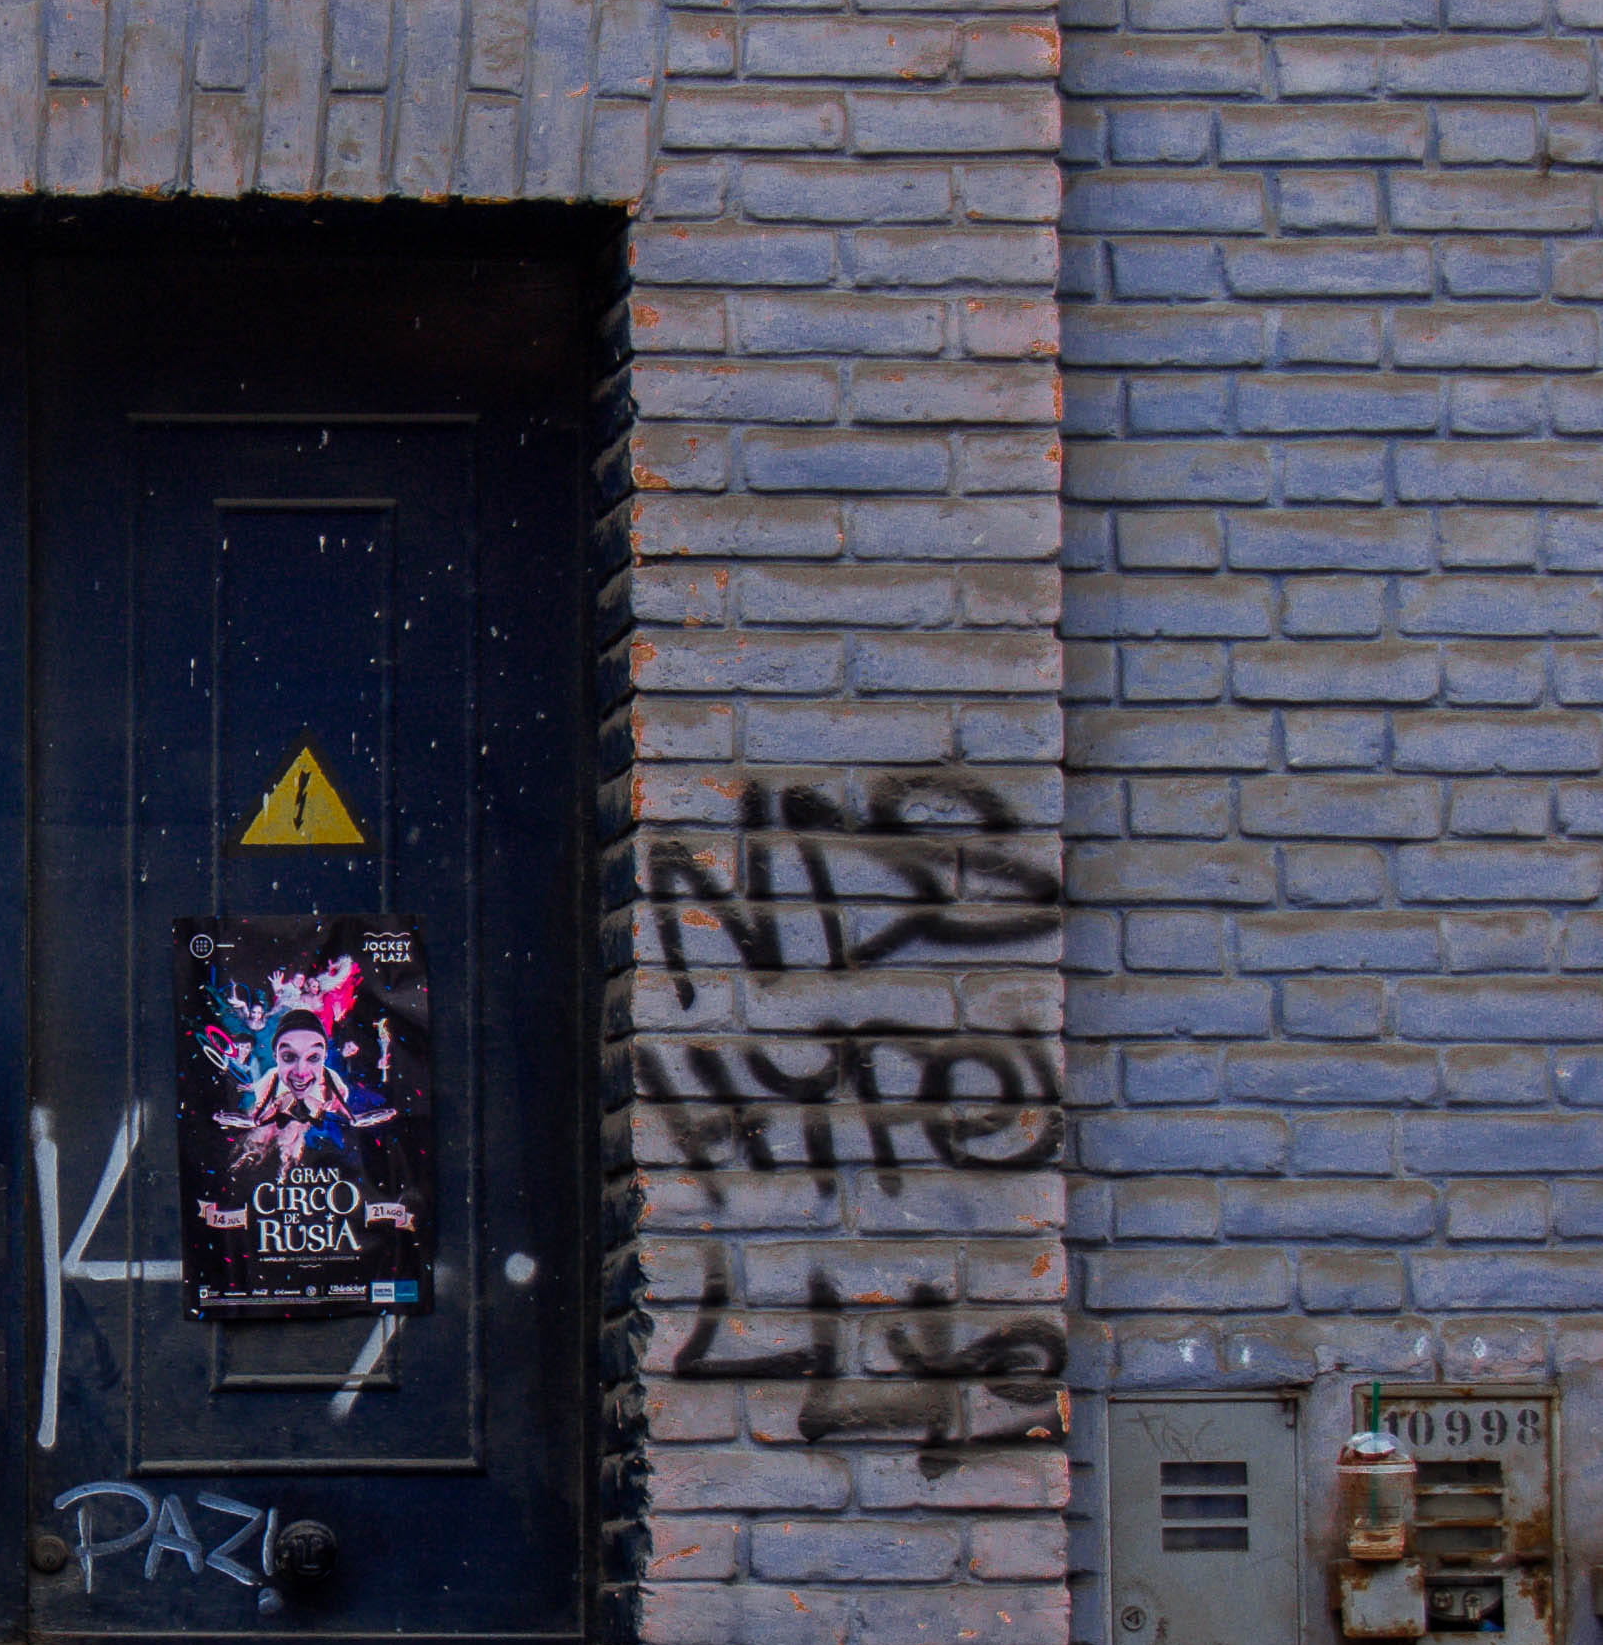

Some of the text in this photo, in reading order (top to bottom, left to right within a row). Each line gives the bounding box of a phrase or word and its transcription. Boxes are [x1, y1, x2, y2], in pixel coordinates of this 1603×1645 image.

[362, 941, 412, 952] JOCKEY
[373, 953, 412, 963] PLAZA
[290, 1168, 340, 1184] GRAN
[252, 1180, 361, 1215] CIRCO
[372, 1206, 385, 1217] 21
[212, 1214, 224, 1225] 14
[284, 1213, 300, 1224] DE
[257, 1219, 363, 1252] RUSIA
[1382, 1408, 1542, 1446] 10998
